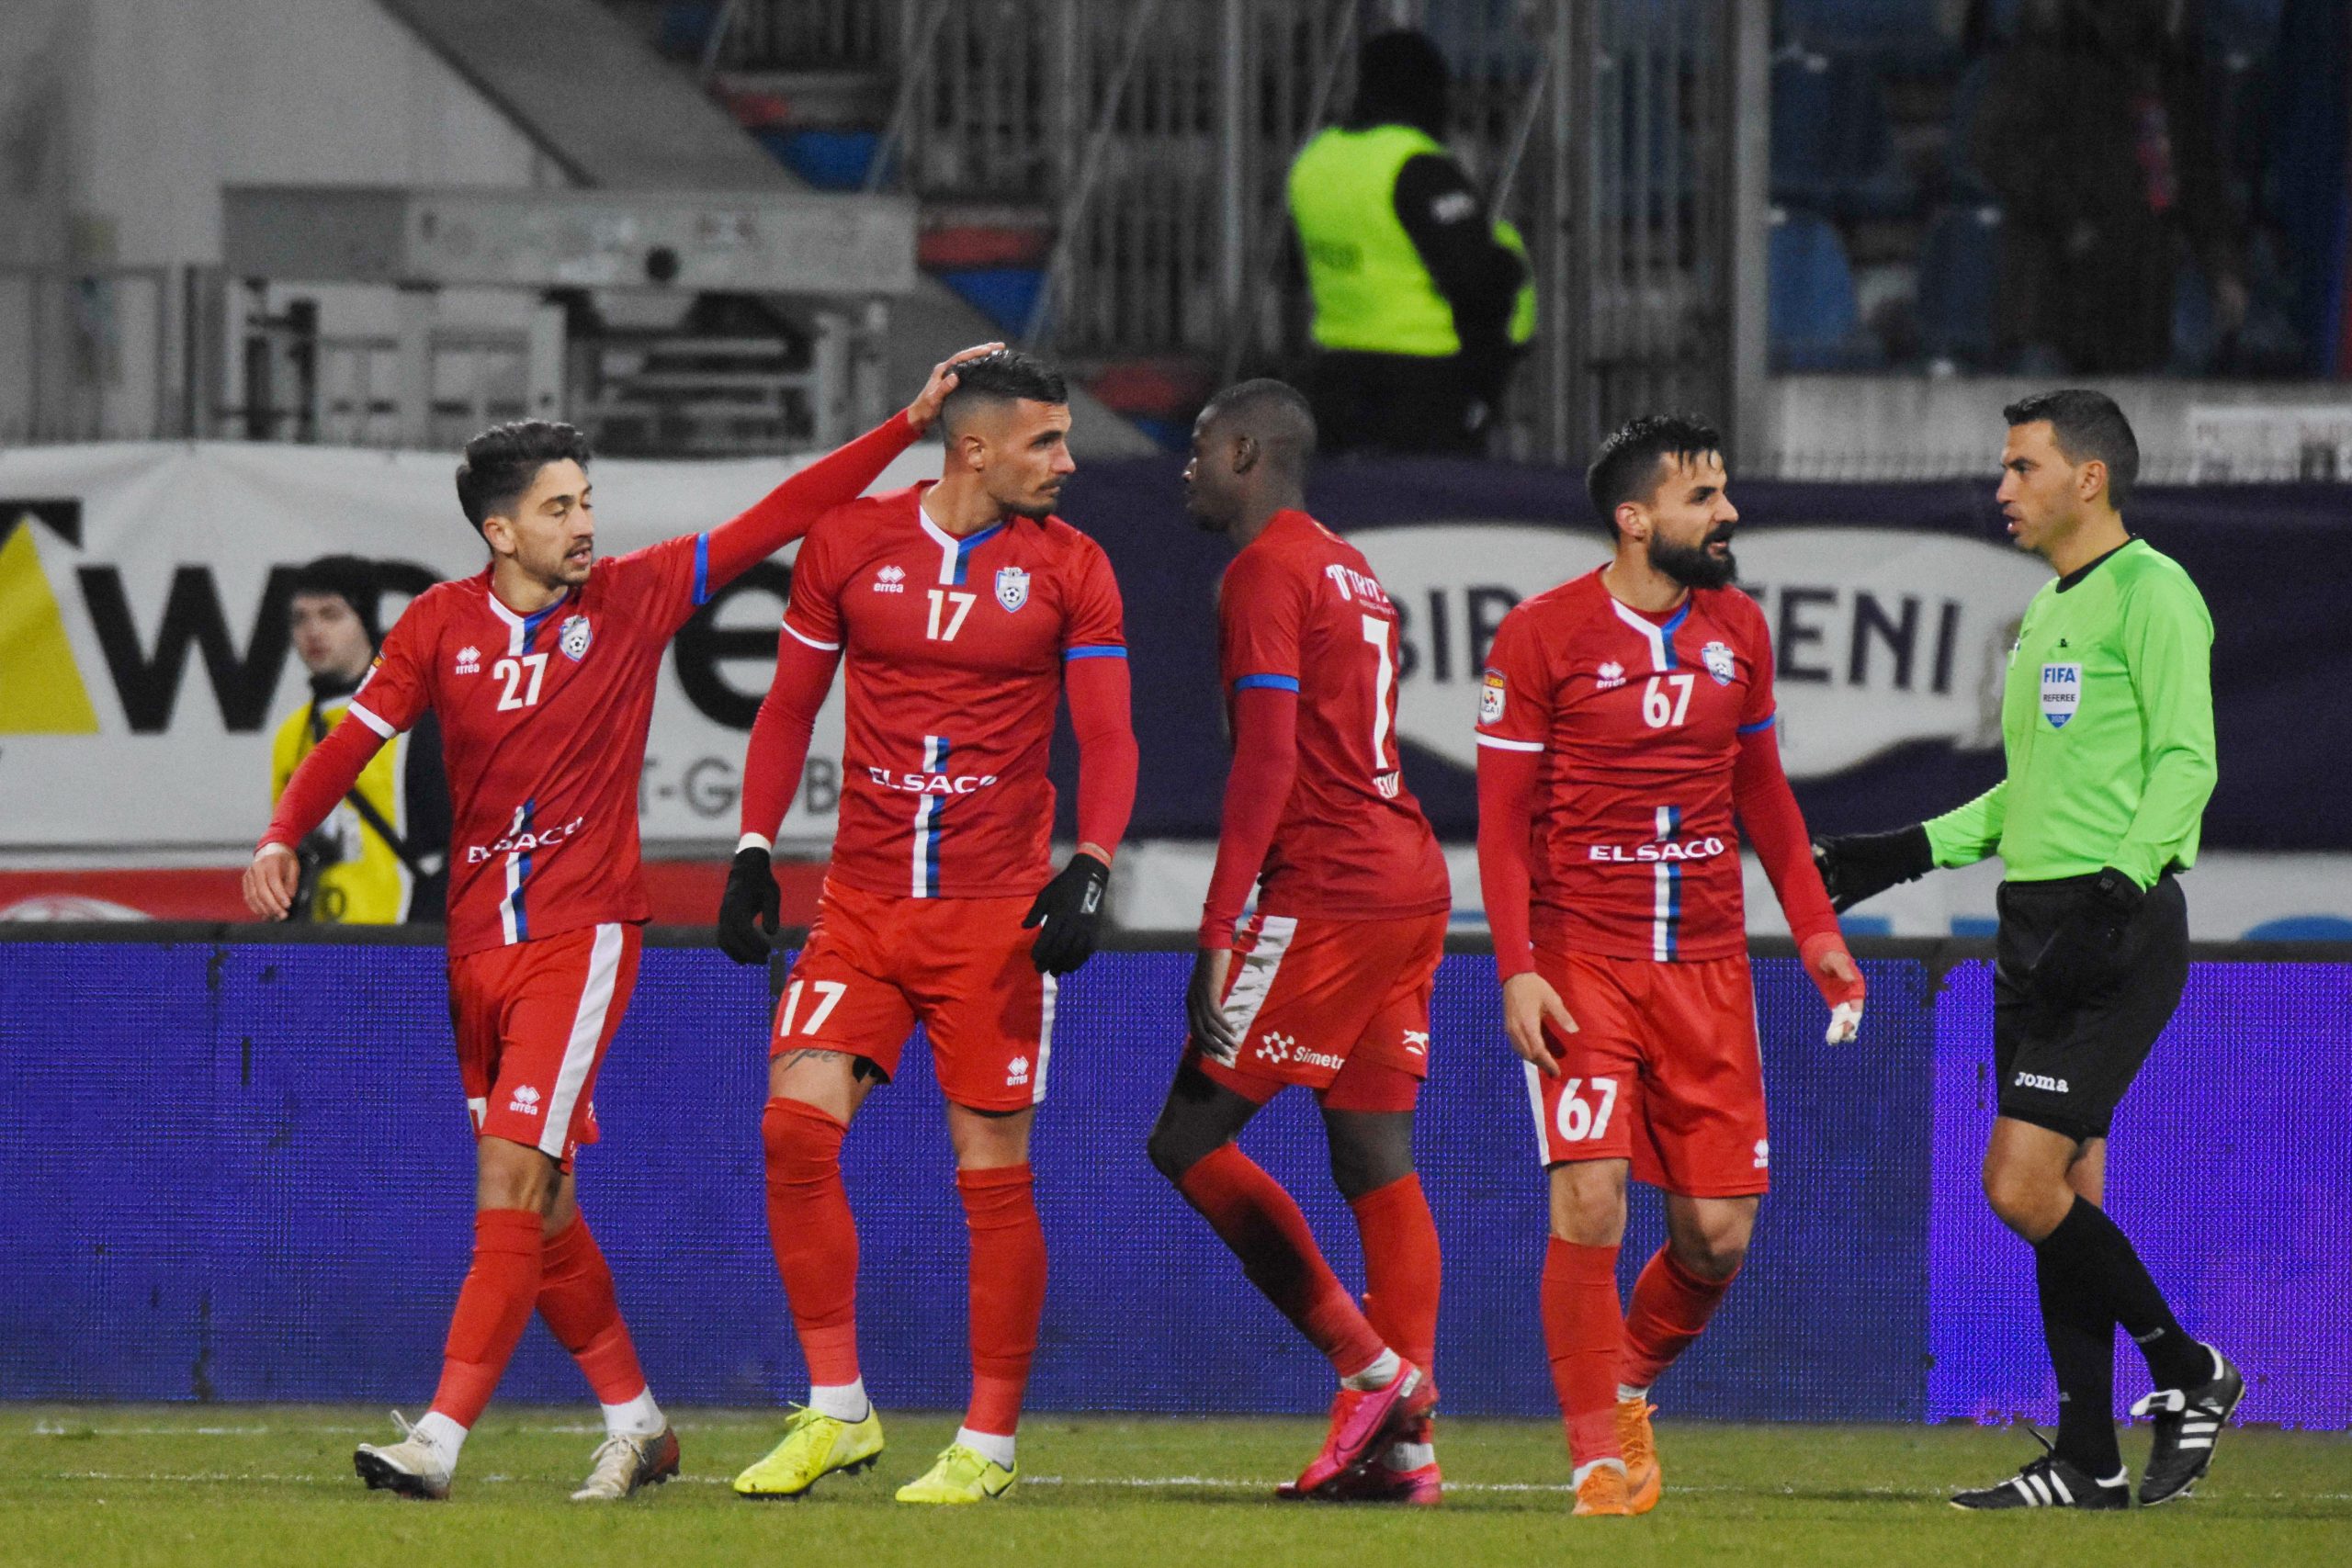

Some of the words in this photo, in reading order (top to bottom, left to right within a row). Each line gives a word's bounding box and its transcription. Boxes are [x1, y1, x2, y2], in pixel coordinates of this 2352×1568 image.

[926, 589, 978, 642] 17
[493, 652, 549, 712] 27
[1362, 614, 1390, 769] 7
[1642, 673, 1695, 728] 67
[2042, 693, 2076, 703] REFEREE
[2043, 667, 2076, 683] FIFA
[868, 765, 997, 794] ELSACO
[1589, 836, 1724, 863] ELSACO
[780, 980, 848, 1038] 17
[1556, 1077, 1618, 1142] 67
